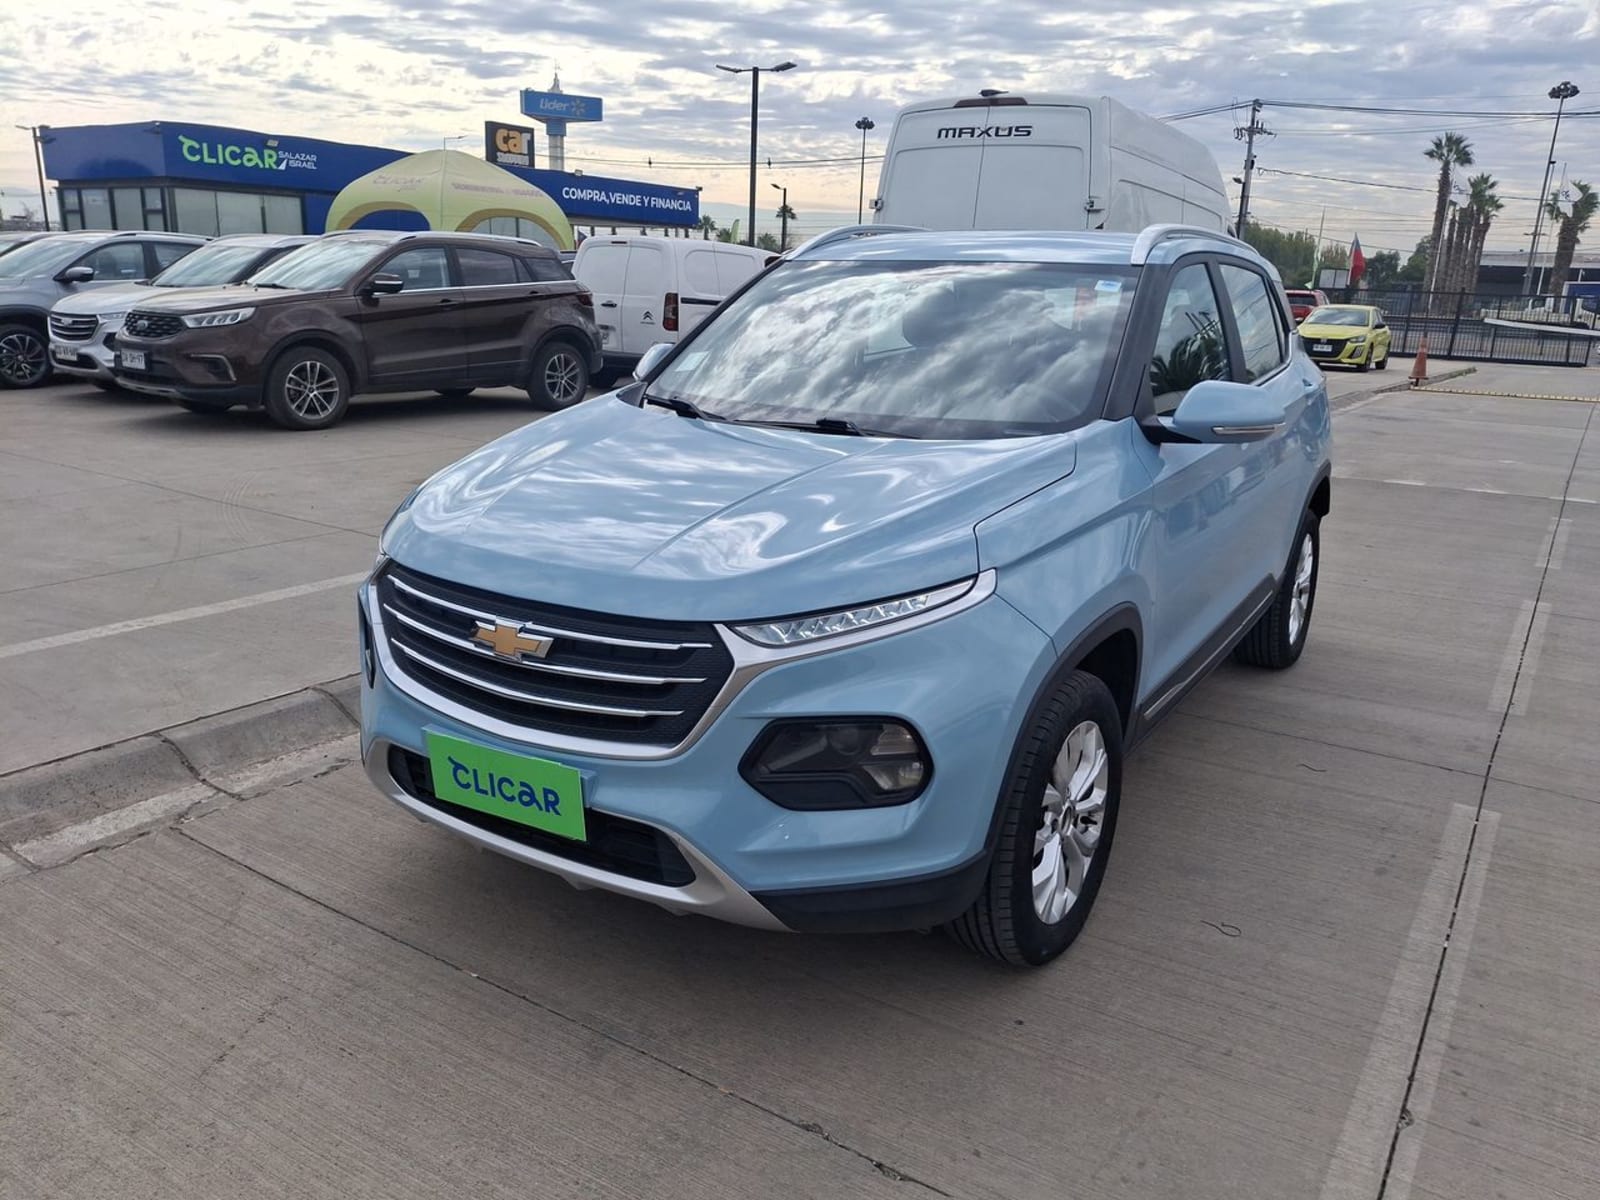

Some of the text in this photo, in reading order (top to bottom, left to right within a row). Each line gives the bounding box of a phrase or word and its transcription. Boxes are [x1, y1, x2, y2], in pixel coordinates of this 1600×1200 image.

[937, 125, 1033, 139] MAXUS
[278, 150, 317, 162] SALAZAR
[288, 159, 317, 170] ISRAEL
[643, 196, 650, 207] Y
[650, 197, 692, 212] FINANCIA
